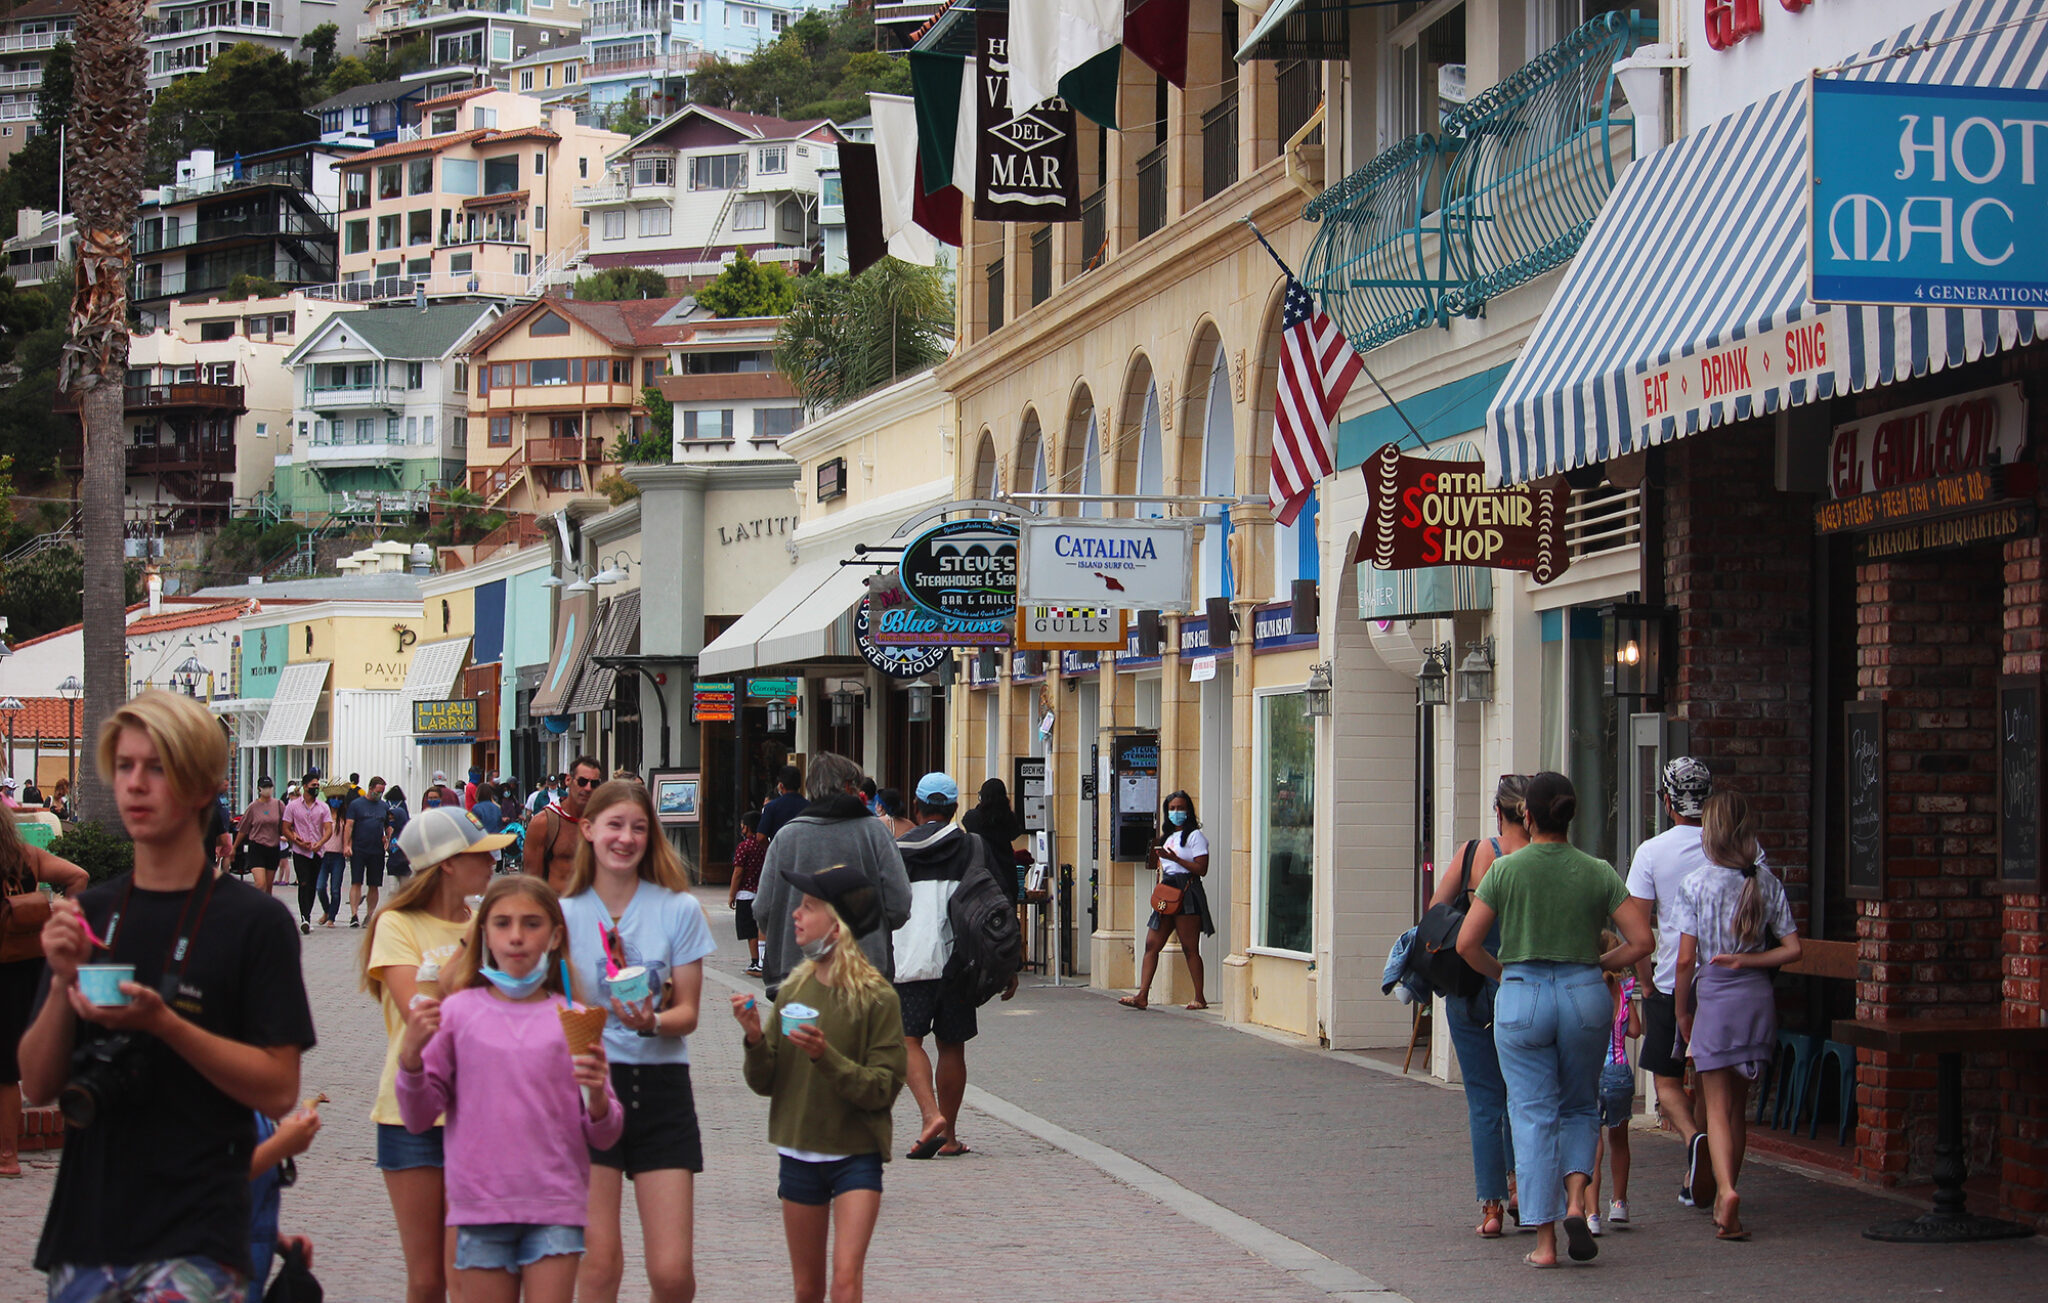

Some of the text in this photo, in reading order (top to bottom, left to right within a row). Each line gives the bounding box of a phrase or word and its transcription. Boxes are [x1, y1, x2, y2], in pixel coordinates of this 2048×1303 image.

[1012, 124, 1044, 141] DEL
[1894, 115, 2048, 185] HOT
[990, 153, 1063, 189] MAR
[1828, 194, 2015, 267] MAC
[1914, 284, 1924, 299] 4
[1643, 321, 1827, 418] EAT DRINK SING
[1832, 397, 1995, 499] EL GALLEON
[1401, 487, 1532, 529] SOUVENIR
[1820, 471, 1984, 532] AGED STEAKS FRESH FISH PRIME RIB
[718, 516, 797, 546] LATIT
[1868, 508, 2018, 558] KARAOKE HEADQUARTERS
[1054, 534, 1158, 560] CATALINA
[1422, 526, 1504, 563] SHOP
[940, 556, 1015, 571] STEVE'S
[1078, 561, 1135, 570] ISLAND SURF CO.
[915, 572, 982, 587] STEAKHOUSE
[985, 571, 993, 586] &
[942, 595, 962, 605] BAR
[879, 609, 938, 633] Blue
[1035, 619, 1108, 633] GULLS
[859, 637, 898, 673] BREW
[902, 646, 948, 675] HOUS
[365, 663, 407, 675] PAVIL
[418, 702, 473, 716] LUAU
[418, 716, 474, 731] LARRYS
[1022, 766, 1035, 775] BREW
